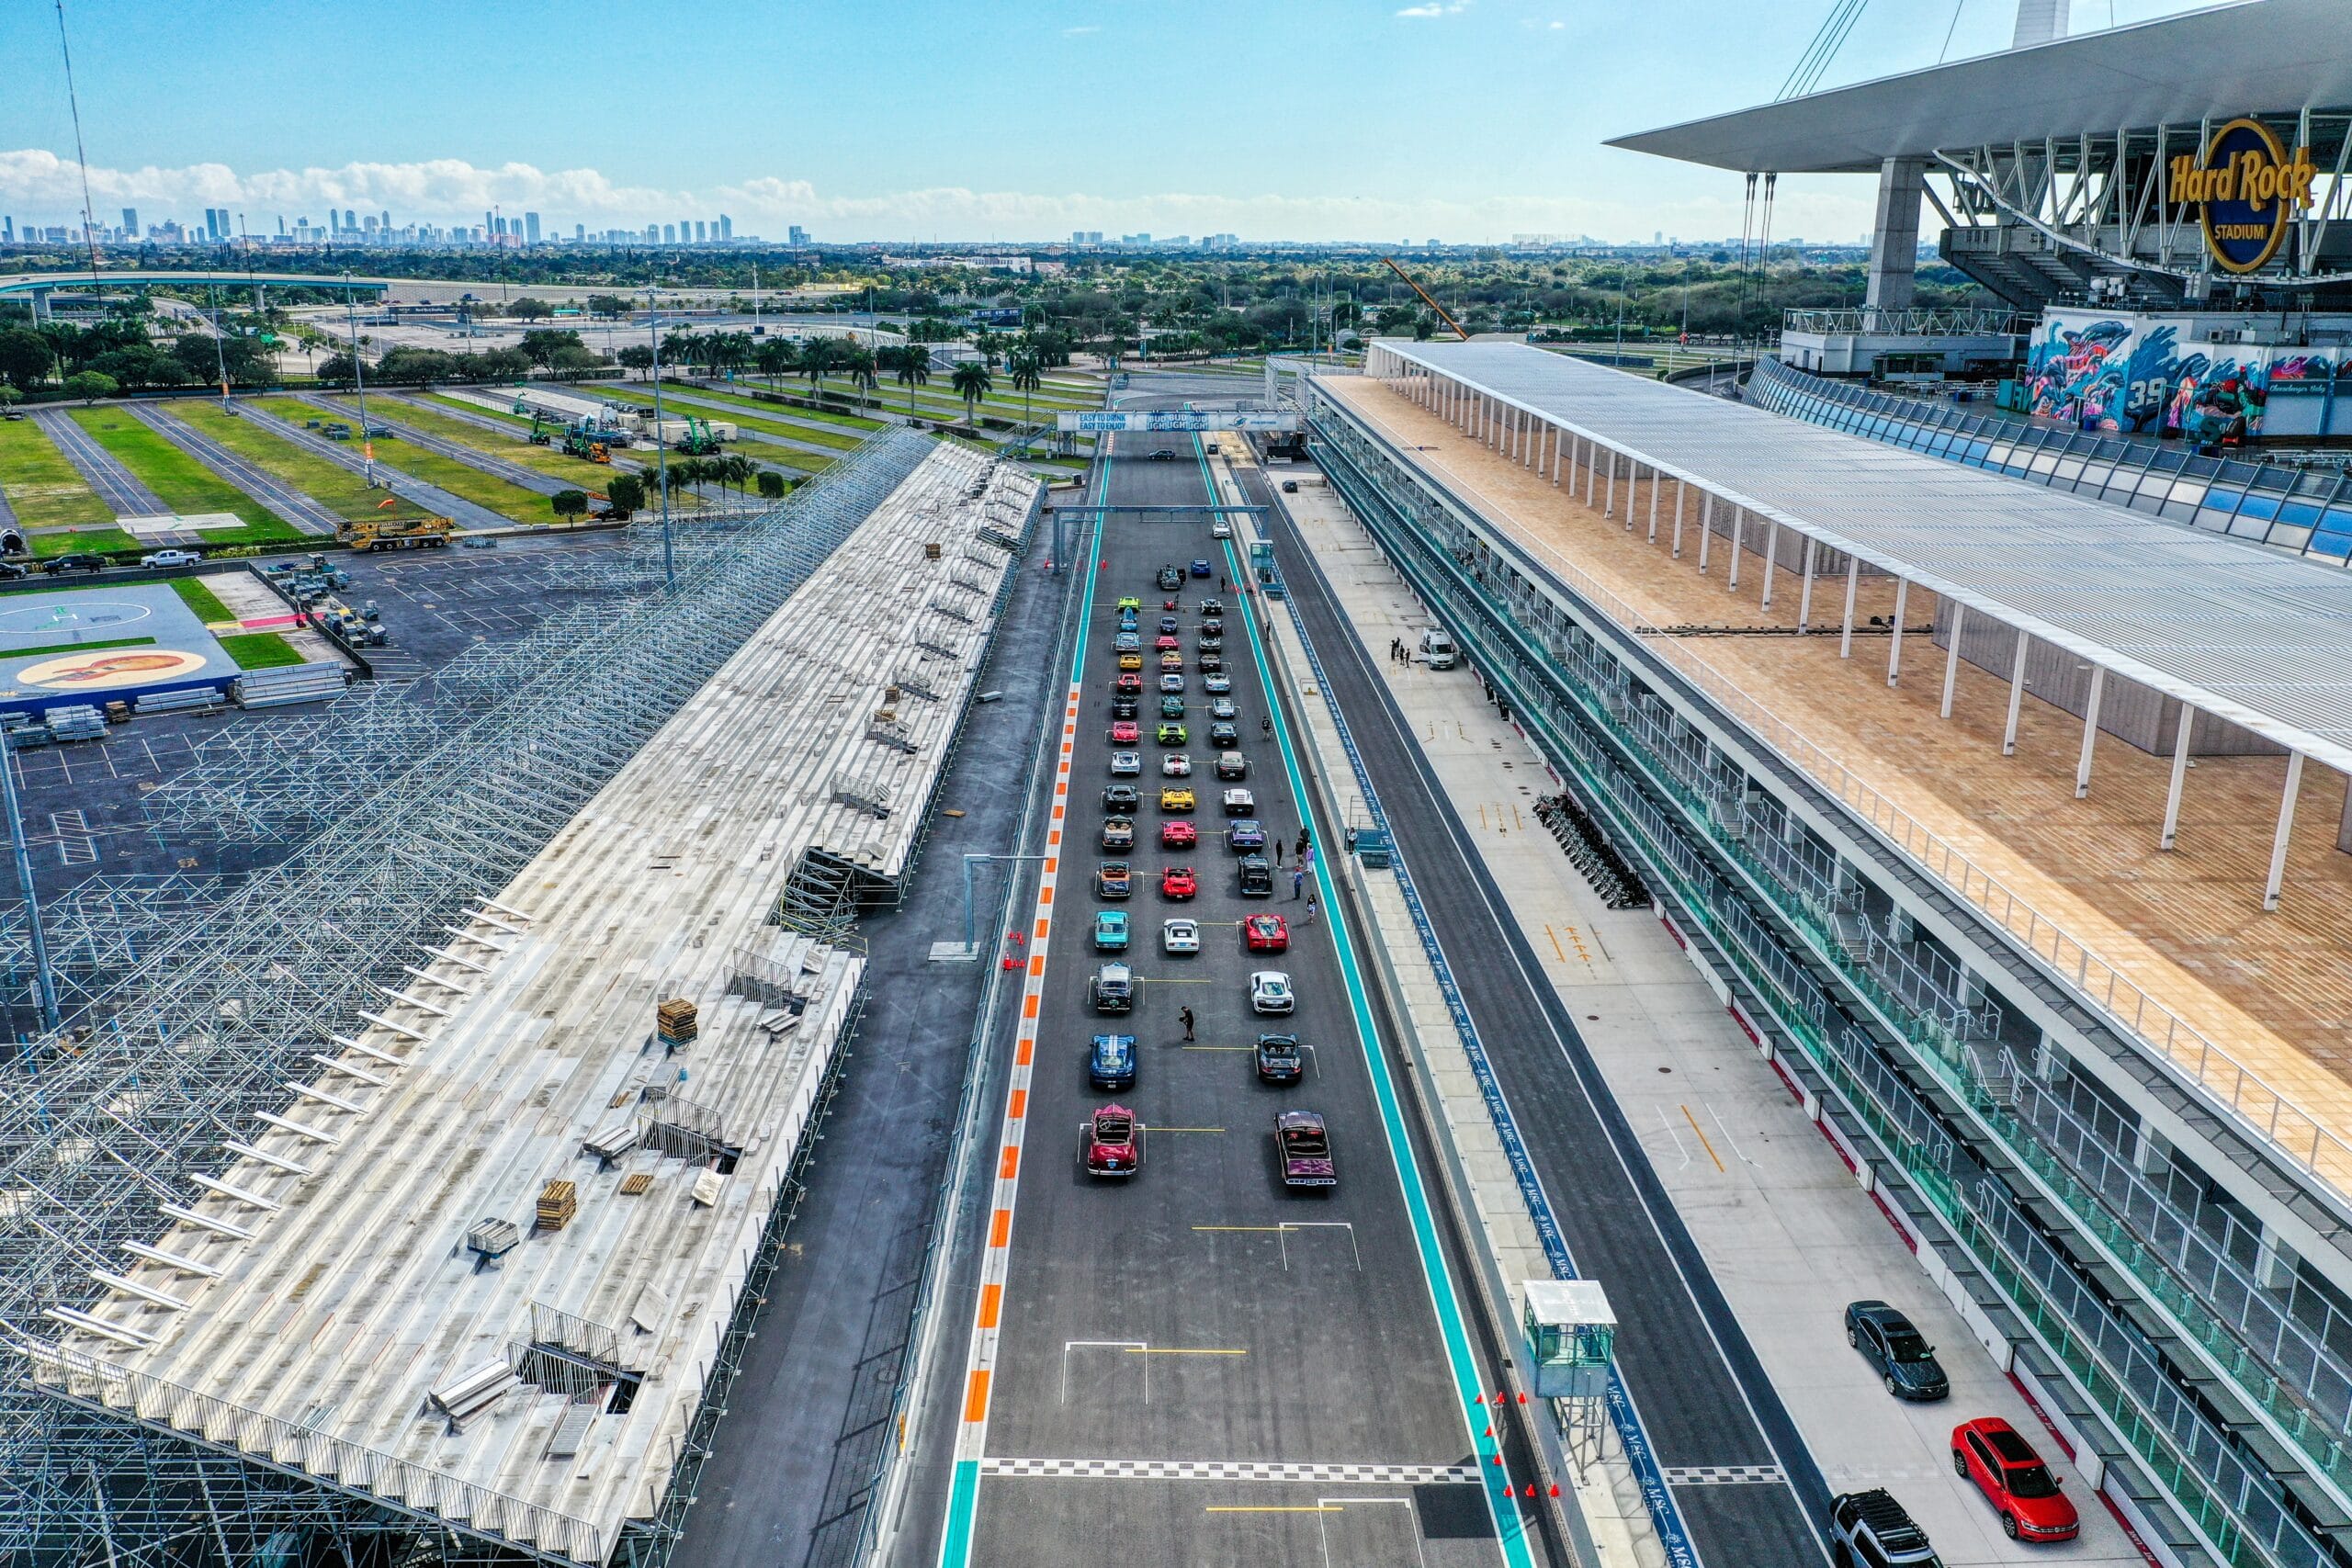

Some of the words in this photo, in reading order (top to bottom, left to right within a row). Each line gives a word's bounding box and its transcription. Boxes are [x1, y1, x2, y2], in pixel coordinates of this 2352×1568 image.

[2169, 152, 2239, 203] Hard
[2240, 147, 2317, 212] Rock
[2215, 224, 2266, 240] STADIUM
[2128, 378, 2167, 409] 39
[1526, 1189, 1542, 1205] MSC
[1540, 1223, 1555, 1240] MSC
[1555, 1258, 1572, 1277] MSC
[1607, 1385, 1625, 1408] MSC
[1626, 1435, 1647, 1460] MSC
[1646, 1488, 1670, 1515] MSC
